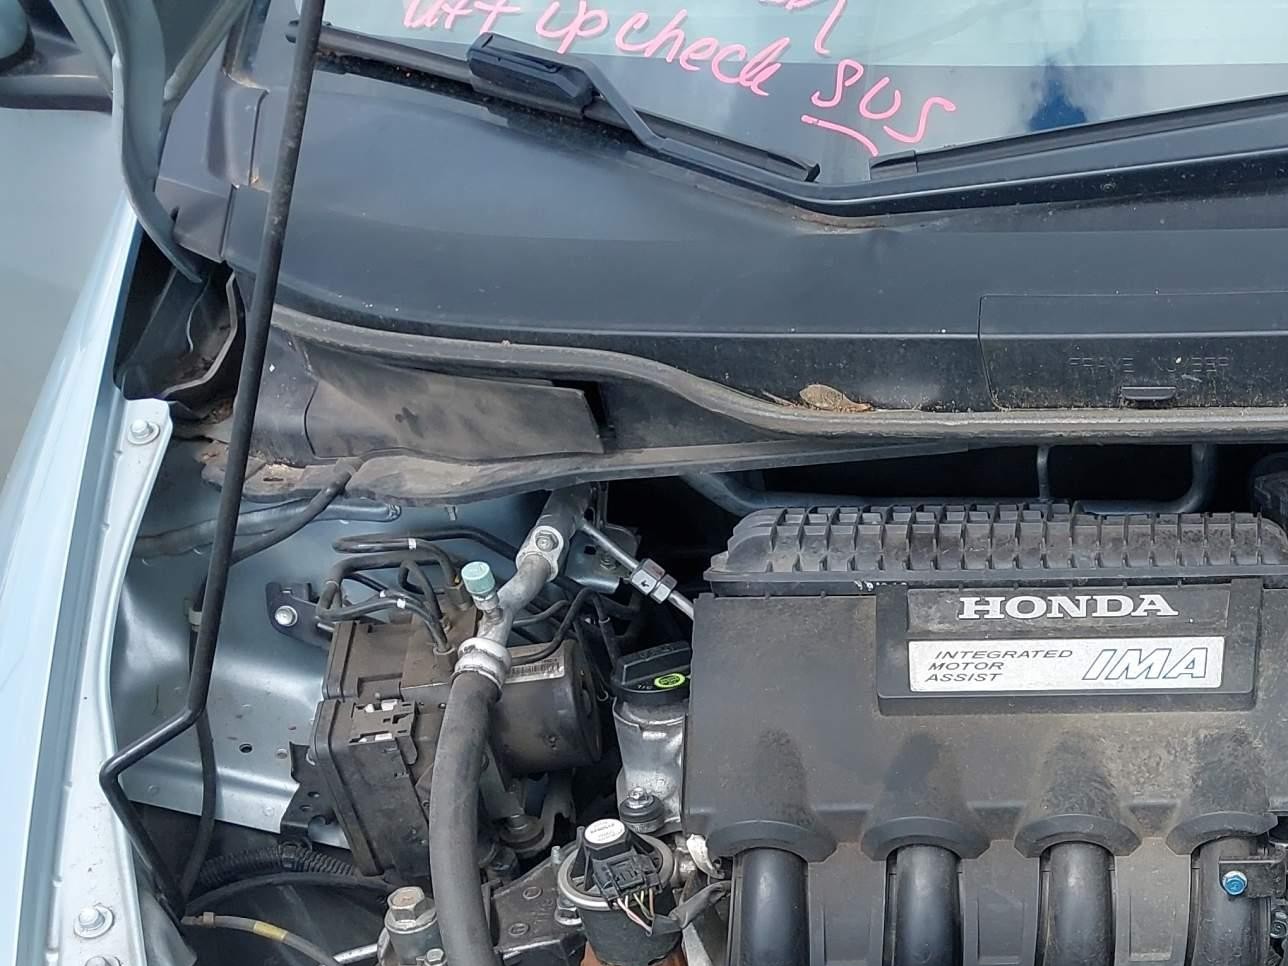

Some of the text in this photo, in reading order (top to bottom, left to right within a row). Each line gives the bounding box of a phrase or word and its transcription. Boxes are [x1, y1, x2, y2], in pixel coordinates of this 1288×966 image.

[615, 8, 791, 96] check
[957, 593, 1180, 620] HONDA
[933, 649, 1074, 660] INTEGRATED
[1081, 647, 1209, 681] IMA
[927, 661, 1005, 671] MOTOR
[924, 673, 1002, 683] ASSIST
